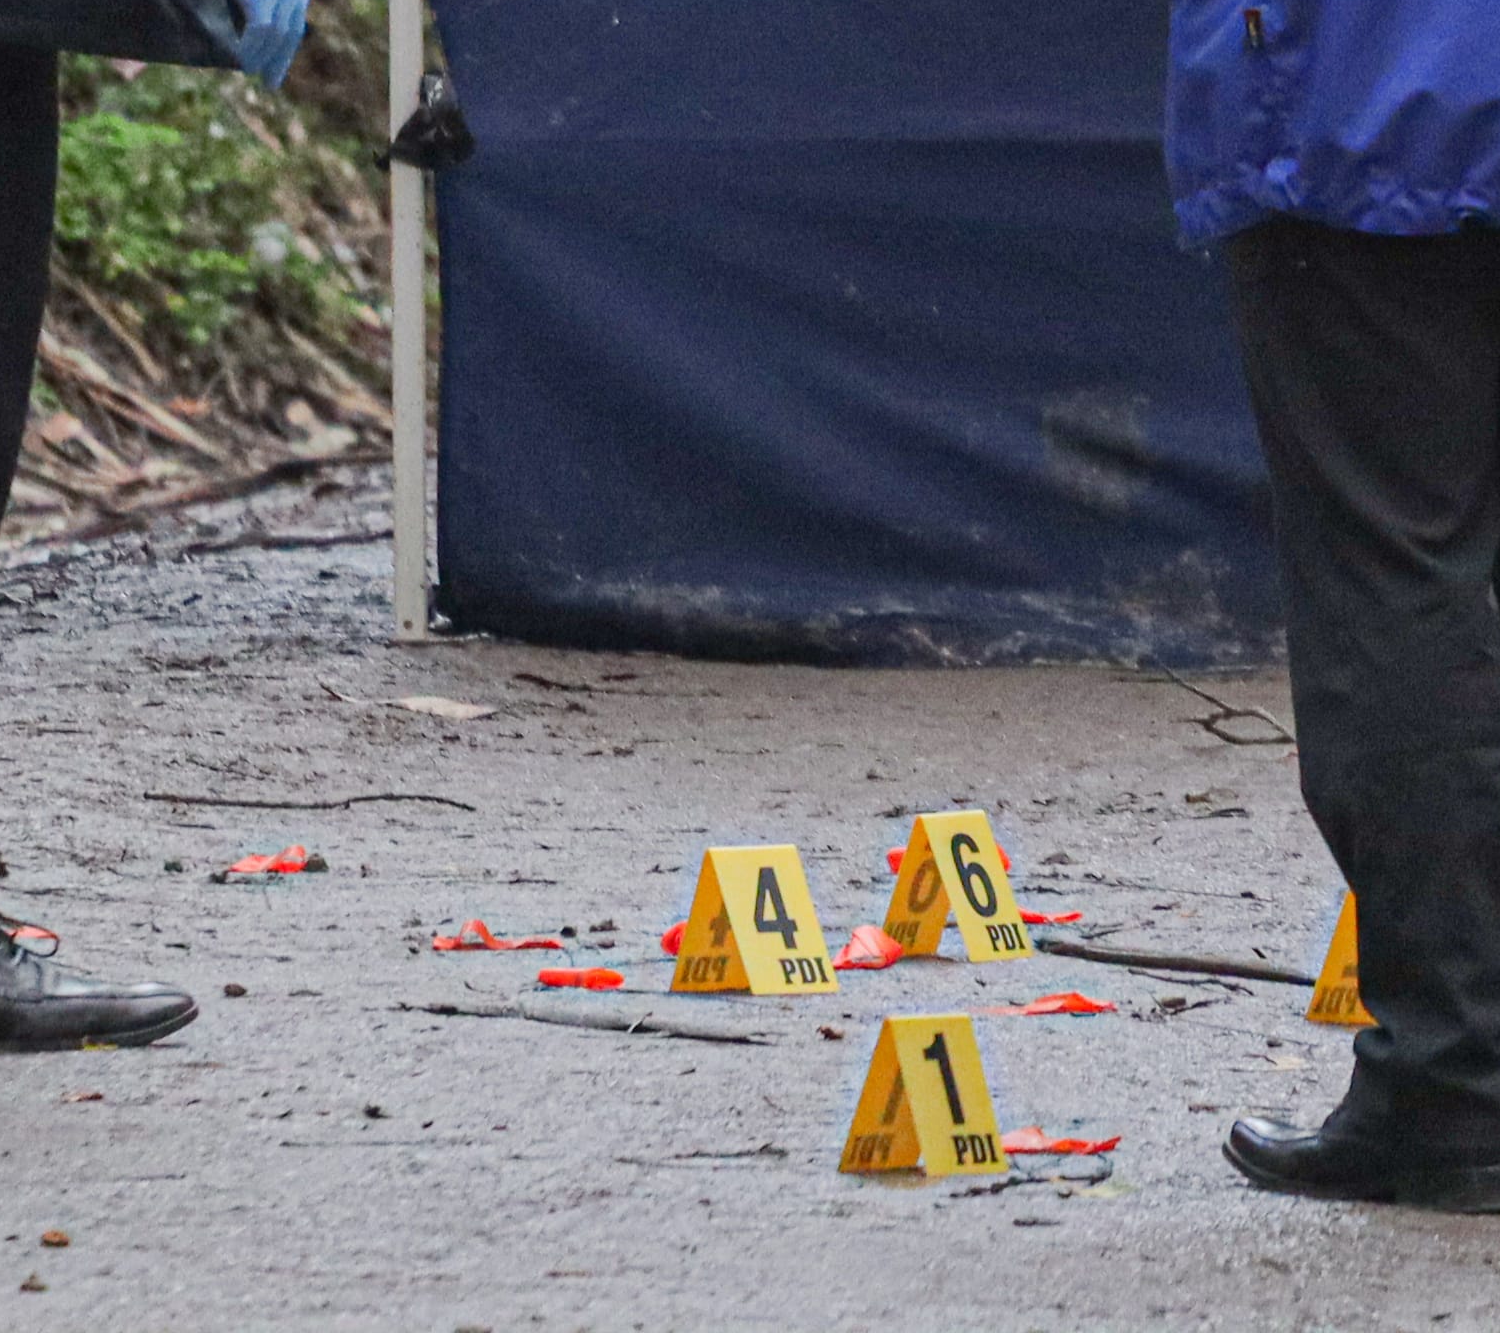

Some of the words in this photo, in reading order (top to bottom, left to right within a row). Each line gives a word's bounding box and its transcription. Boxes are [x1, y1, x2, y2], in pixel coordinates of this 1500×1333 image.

[951, 833, 998, 918] 6
[754, 867, 798, 949] 4
[985, 922, 1027, 952] PDI
[779, 956, 830, 985] PDI
[923, 1032, 965, 1125] 1
[952, 1133, 999, 1166] PDI
